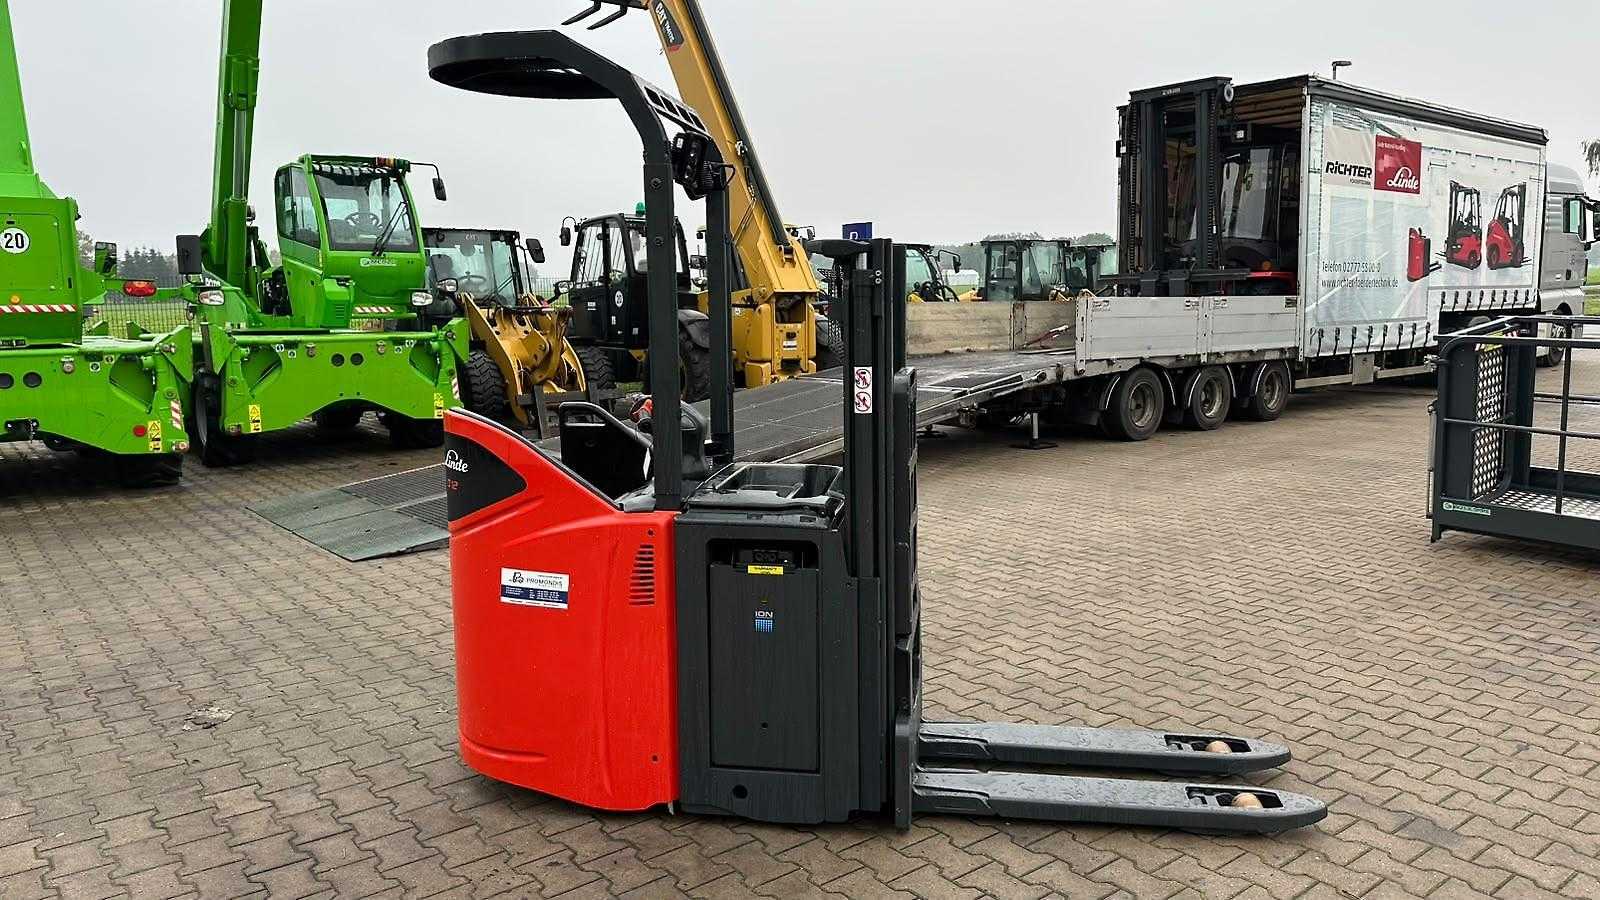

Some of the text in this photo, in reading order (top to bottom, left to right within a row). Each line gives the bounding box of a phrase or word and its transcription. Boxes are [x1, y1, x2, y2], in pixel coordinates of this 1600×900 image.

[655, 2, 667, 25] CAT
[1387, 166, 1419, 189] Linde
[4, 232, 25, 249] 20
[1322, 261, 1342, 273] Telefon
[1342, 262, 1361, 273] 02772
[445, 449, 469, 473] Linde
[755, 610, 773, 618] ION
